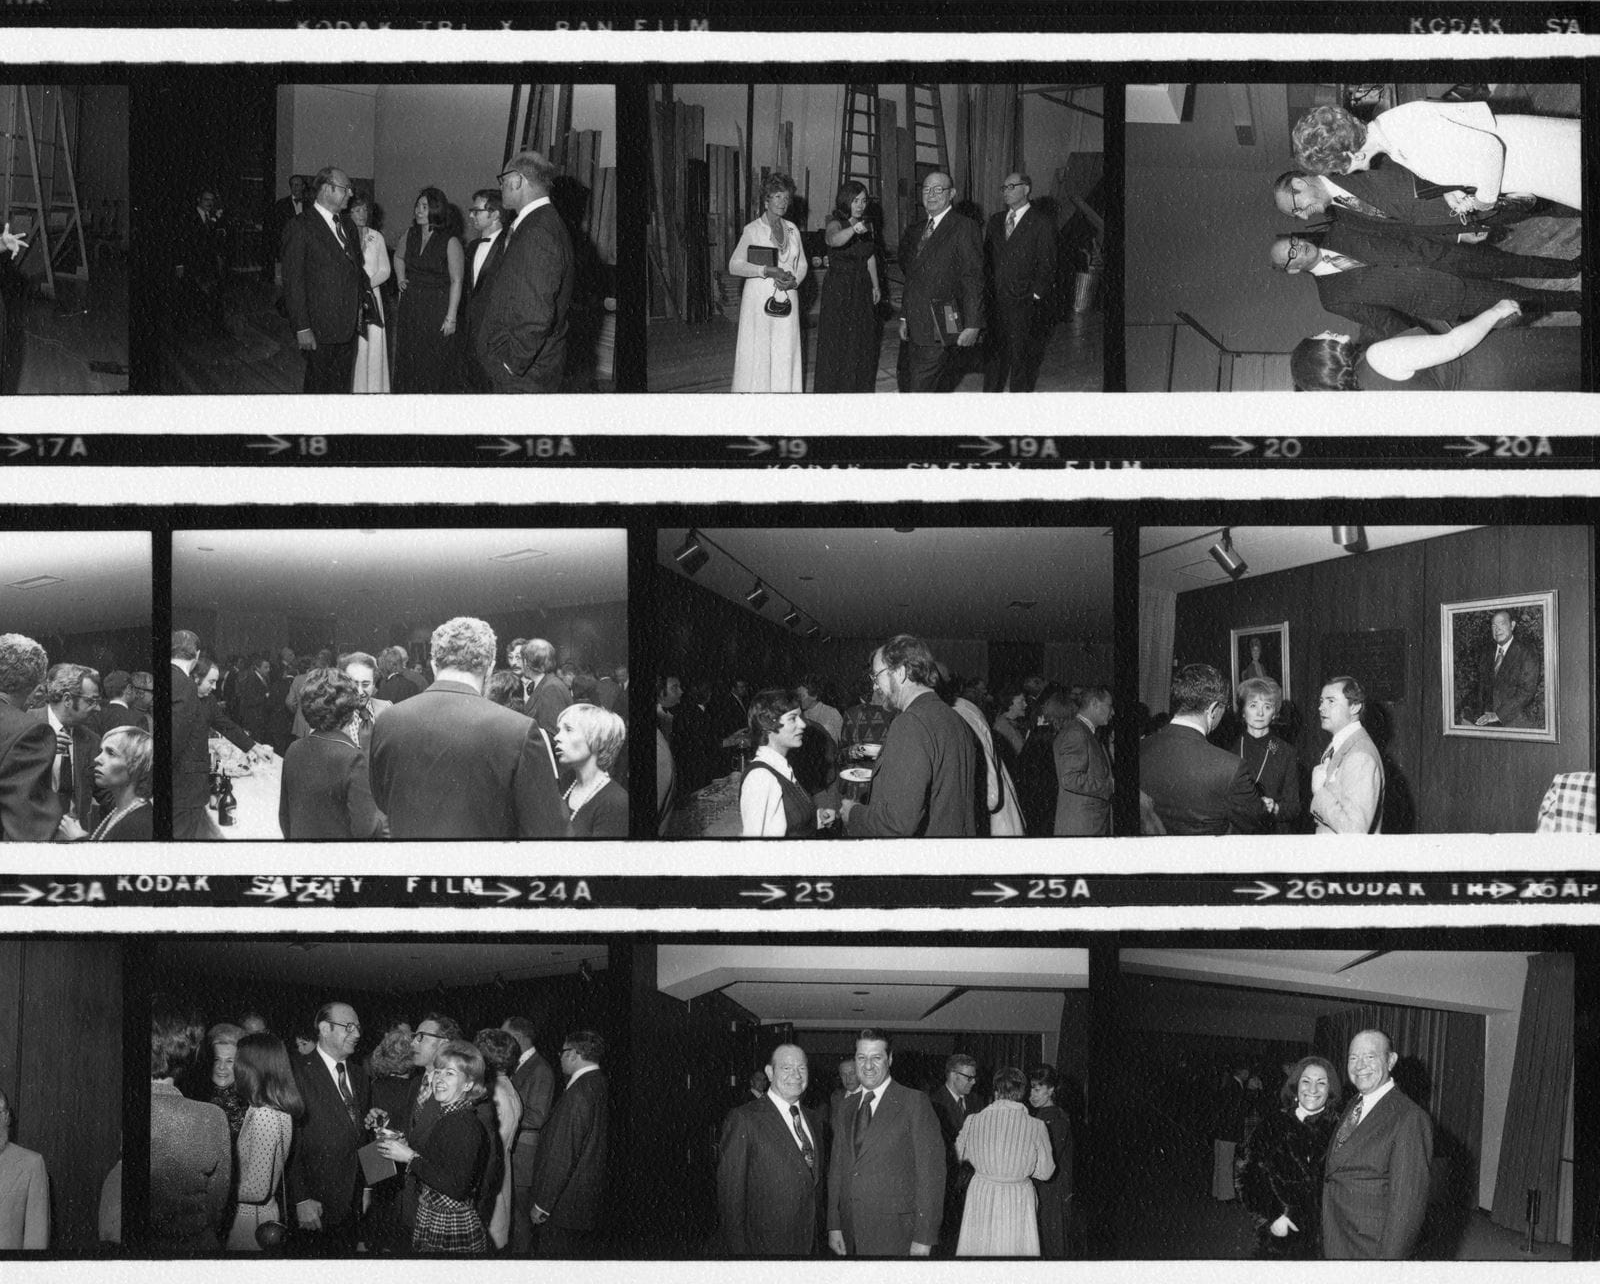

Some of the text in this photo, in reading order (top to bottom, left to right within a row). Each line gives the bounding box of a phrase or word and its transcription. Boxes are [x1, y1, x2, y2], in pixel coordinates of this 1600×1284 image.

[1408, 18, 1502, 35] KODAK
[35, 437, 88, 457] 17A
[298, 436, 328, 456] 18
[524, 437, 577, 457] 18A
[777, 438, 809, 458] 19
[1007, 438, 1059, 458] 19A
[1263, 438, 1302, 458] 20
[1493, 436, 1553, 457] 20A
[46, 882, 107, 902] 23A
[116, 876, 486, 894] KODAK SAFETY FILM
[527, 880, 593, 901] 24A
[794, 882, 835, 903] 25
[1027, 878, 1092, 899] 25A
[1285, 879, 1326, 900] 26
[1326, 882, 1427, 897] KODAK
